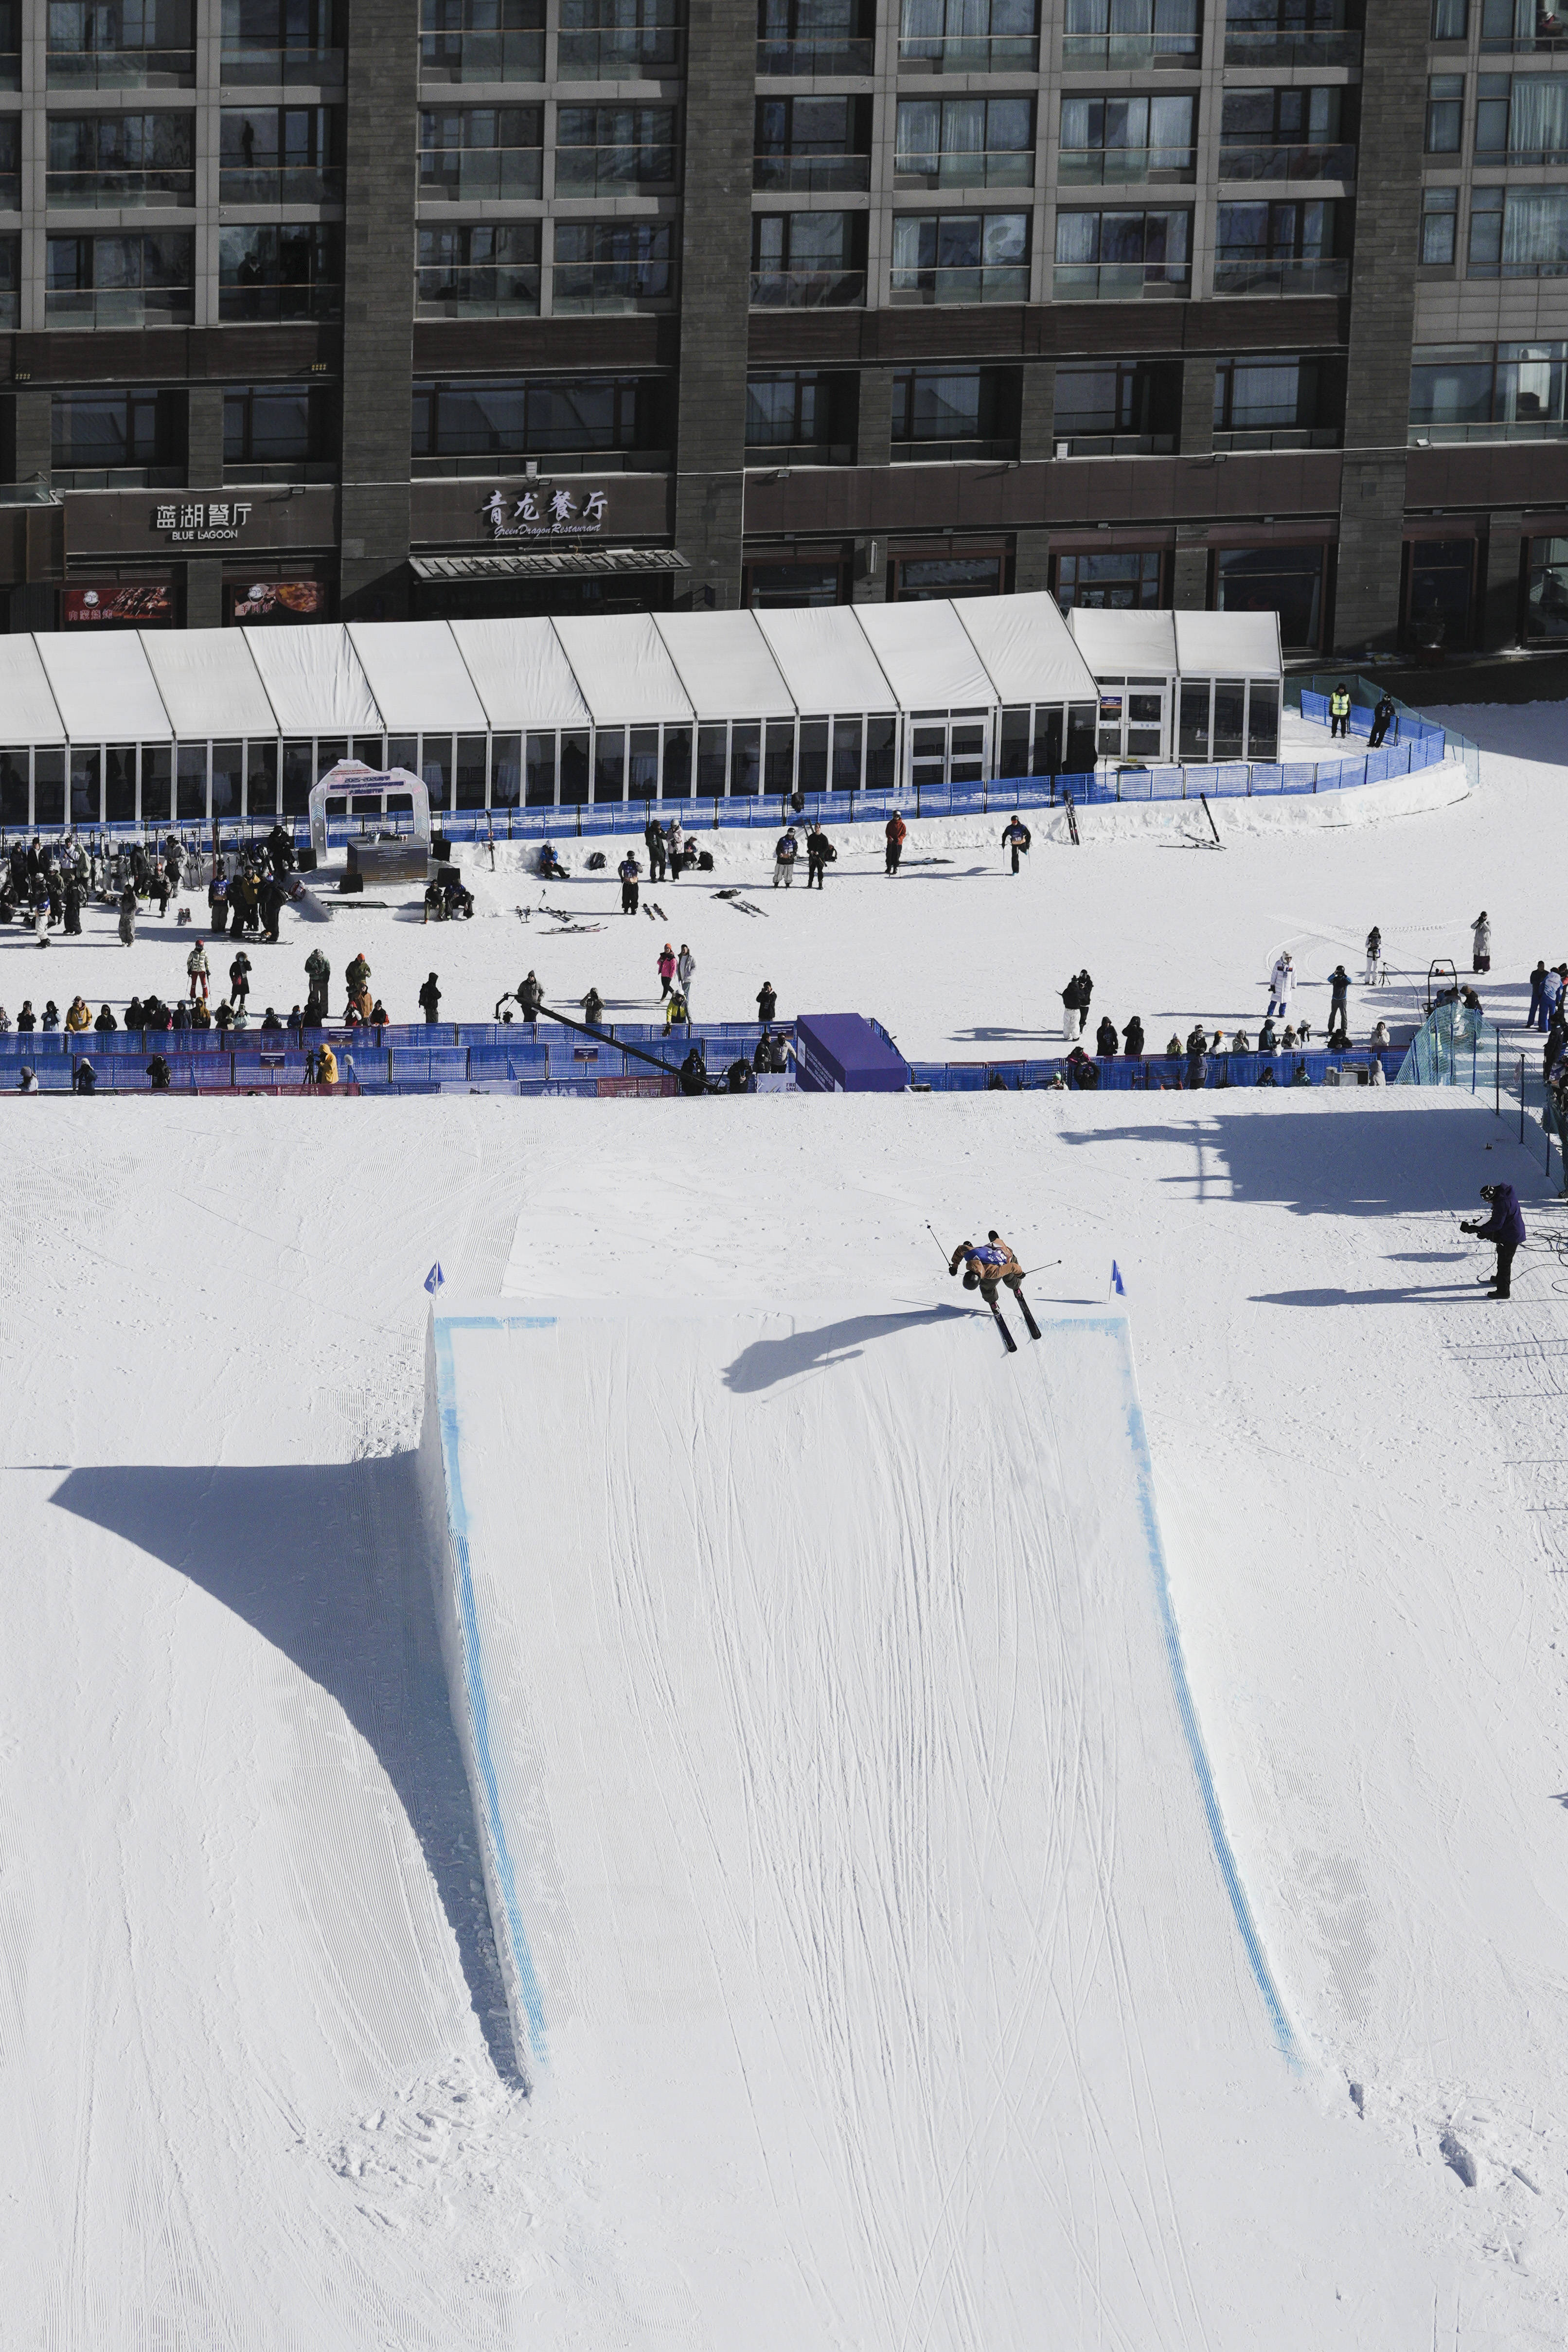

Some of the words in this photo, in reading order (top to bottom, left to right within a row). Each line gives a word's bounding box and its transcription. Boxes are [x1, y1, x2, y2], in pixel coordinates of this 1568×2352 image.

[157, 503, 252, 528] 蓝湖餐厅
[482, 490, 608, 525] 青龙餐厅
[172, 531, 194, 540] BLUE
[197, 530, 238, 540] LAGOON
